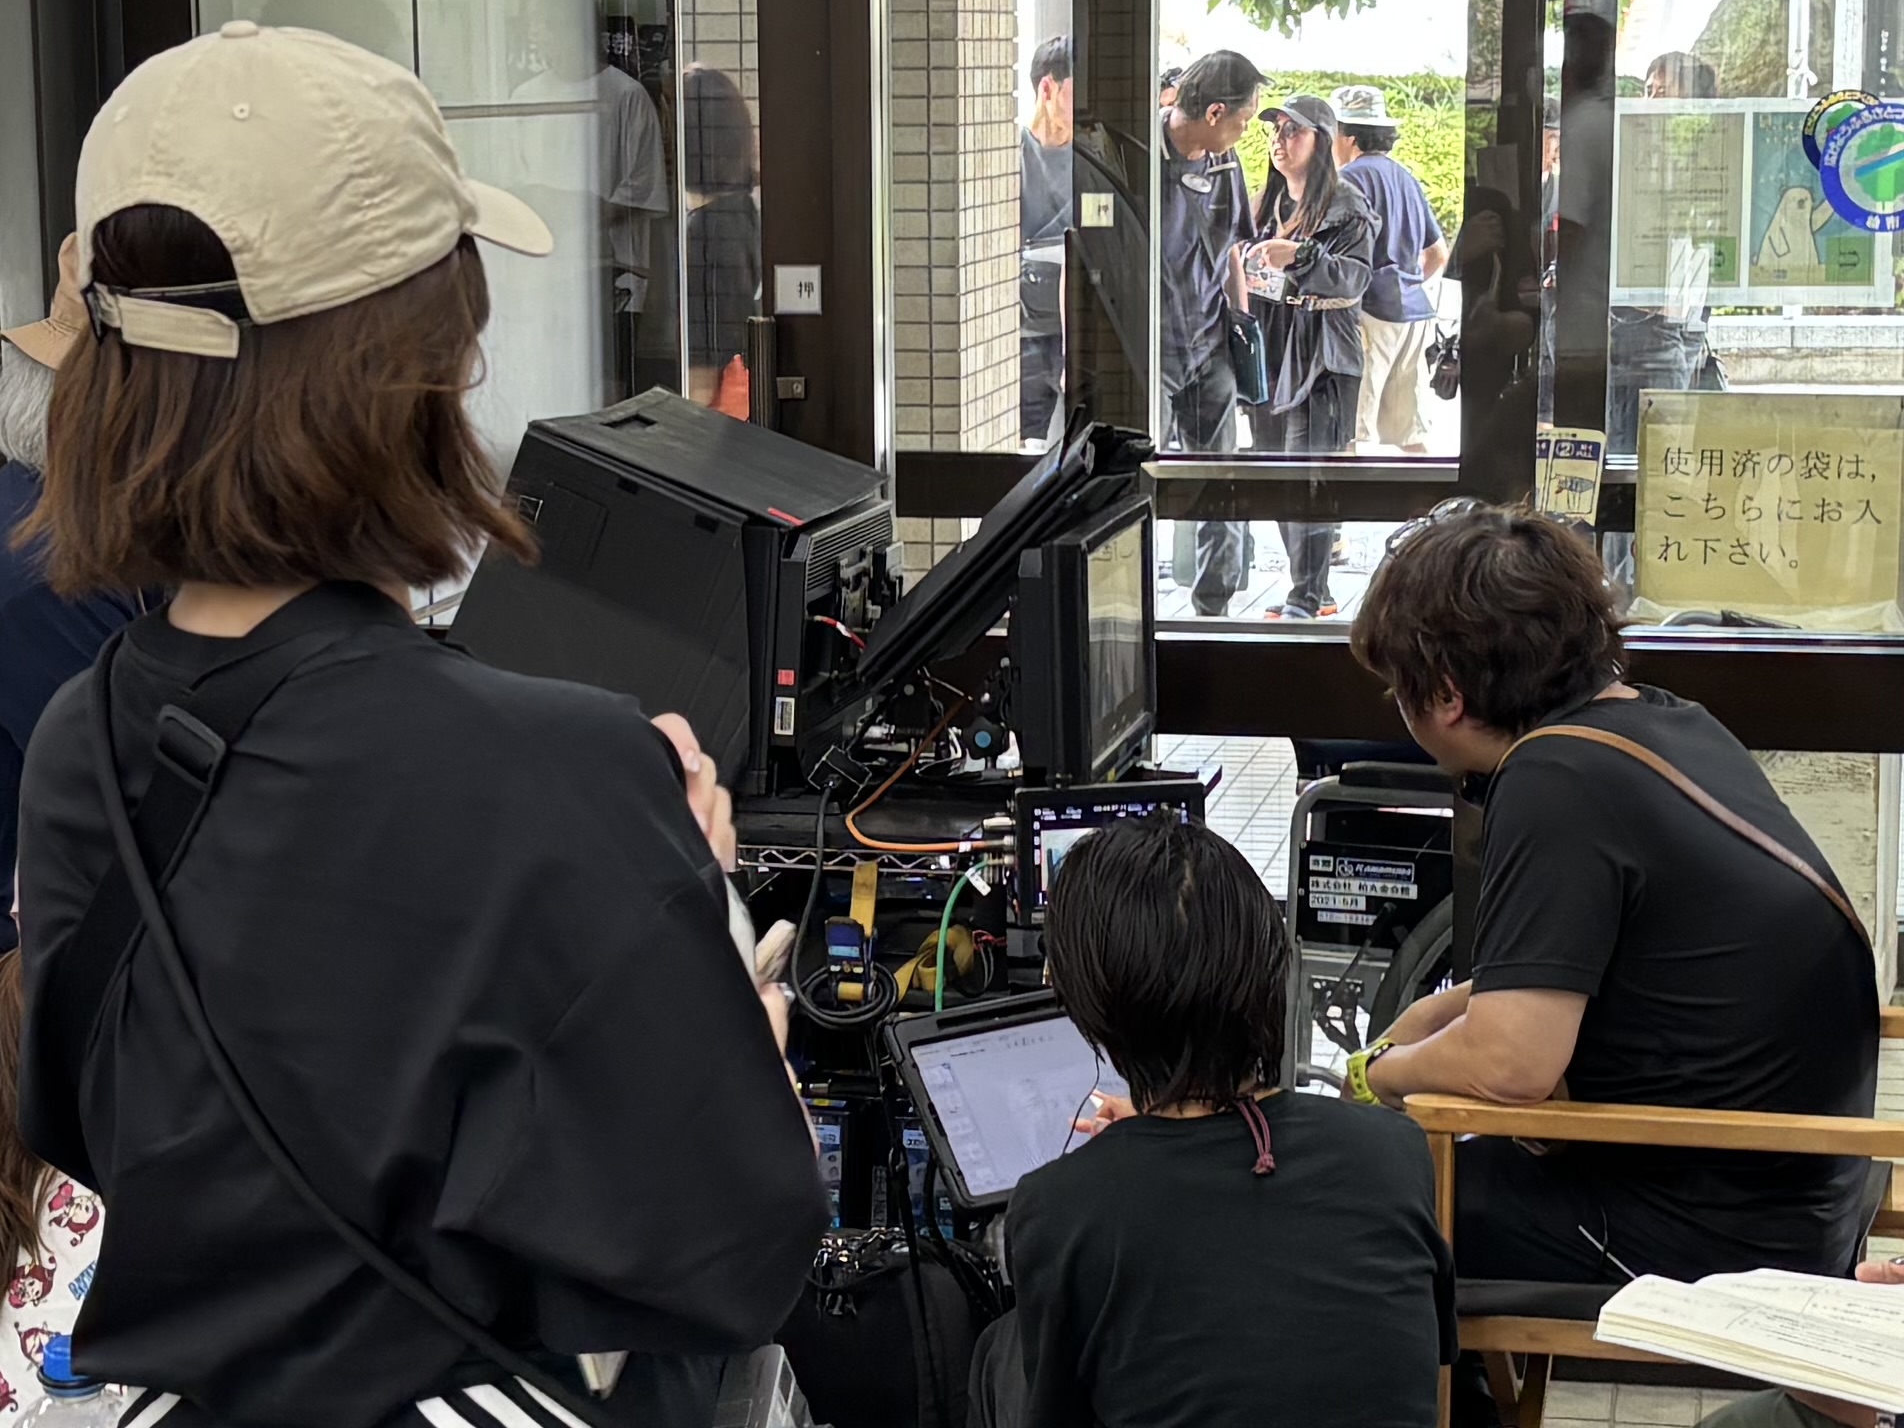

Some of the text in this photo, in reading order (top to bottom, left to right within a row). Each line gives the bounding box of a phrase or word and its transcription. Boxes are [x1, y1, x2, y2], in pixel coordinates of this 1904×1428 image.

[1662, 494, 1883, 525] こちらにお入
[1657, 535, 1802, 570] れ下さい。
